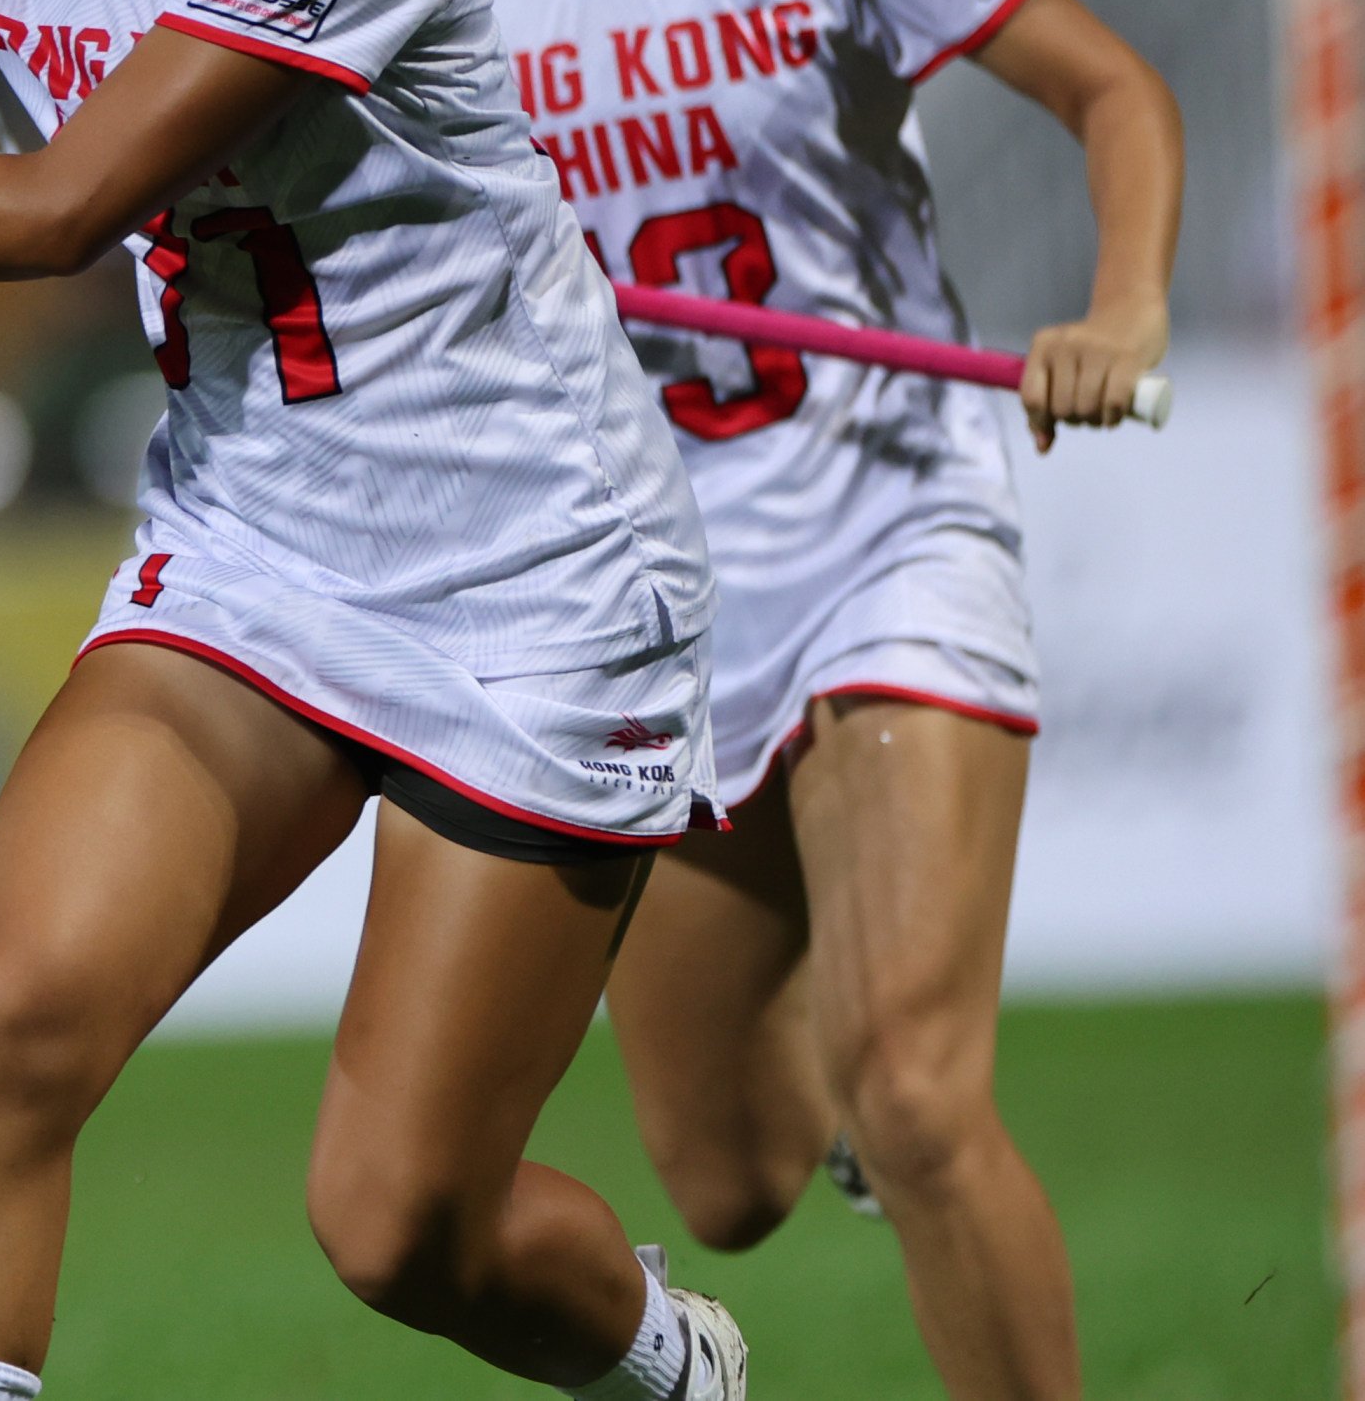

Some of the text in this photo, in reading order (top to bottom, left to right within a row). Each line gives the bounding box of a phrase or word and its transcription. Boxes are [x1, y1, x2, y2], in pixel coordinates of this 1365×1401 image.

[609, 0, 819, 100] KONG
[540, 105, 739, 203] HINA
[578, 760, 632, 777] HONG
